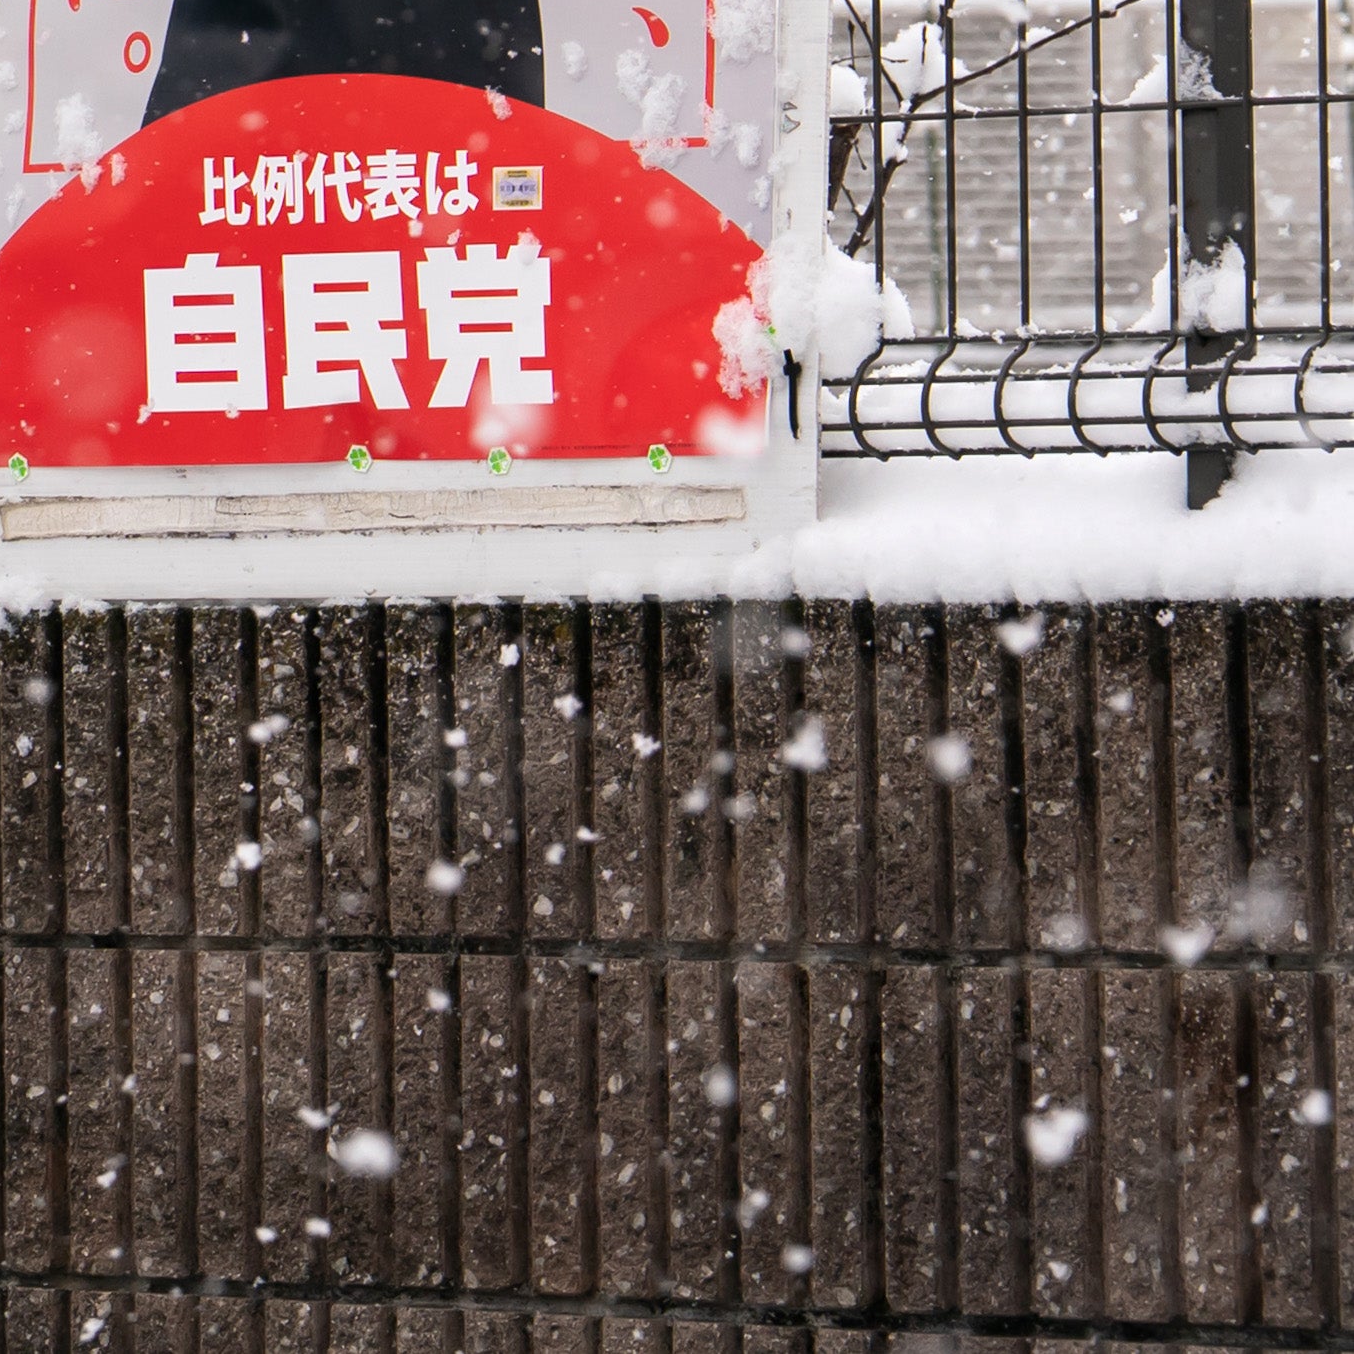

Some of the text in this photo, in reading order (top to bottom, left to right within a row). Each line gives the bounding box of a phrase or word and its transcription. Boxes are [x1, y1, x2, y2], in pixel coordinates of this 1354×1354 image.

[198, 148, 480, 226] 比例代表は
[142, 243, 555, 413] 自民党
